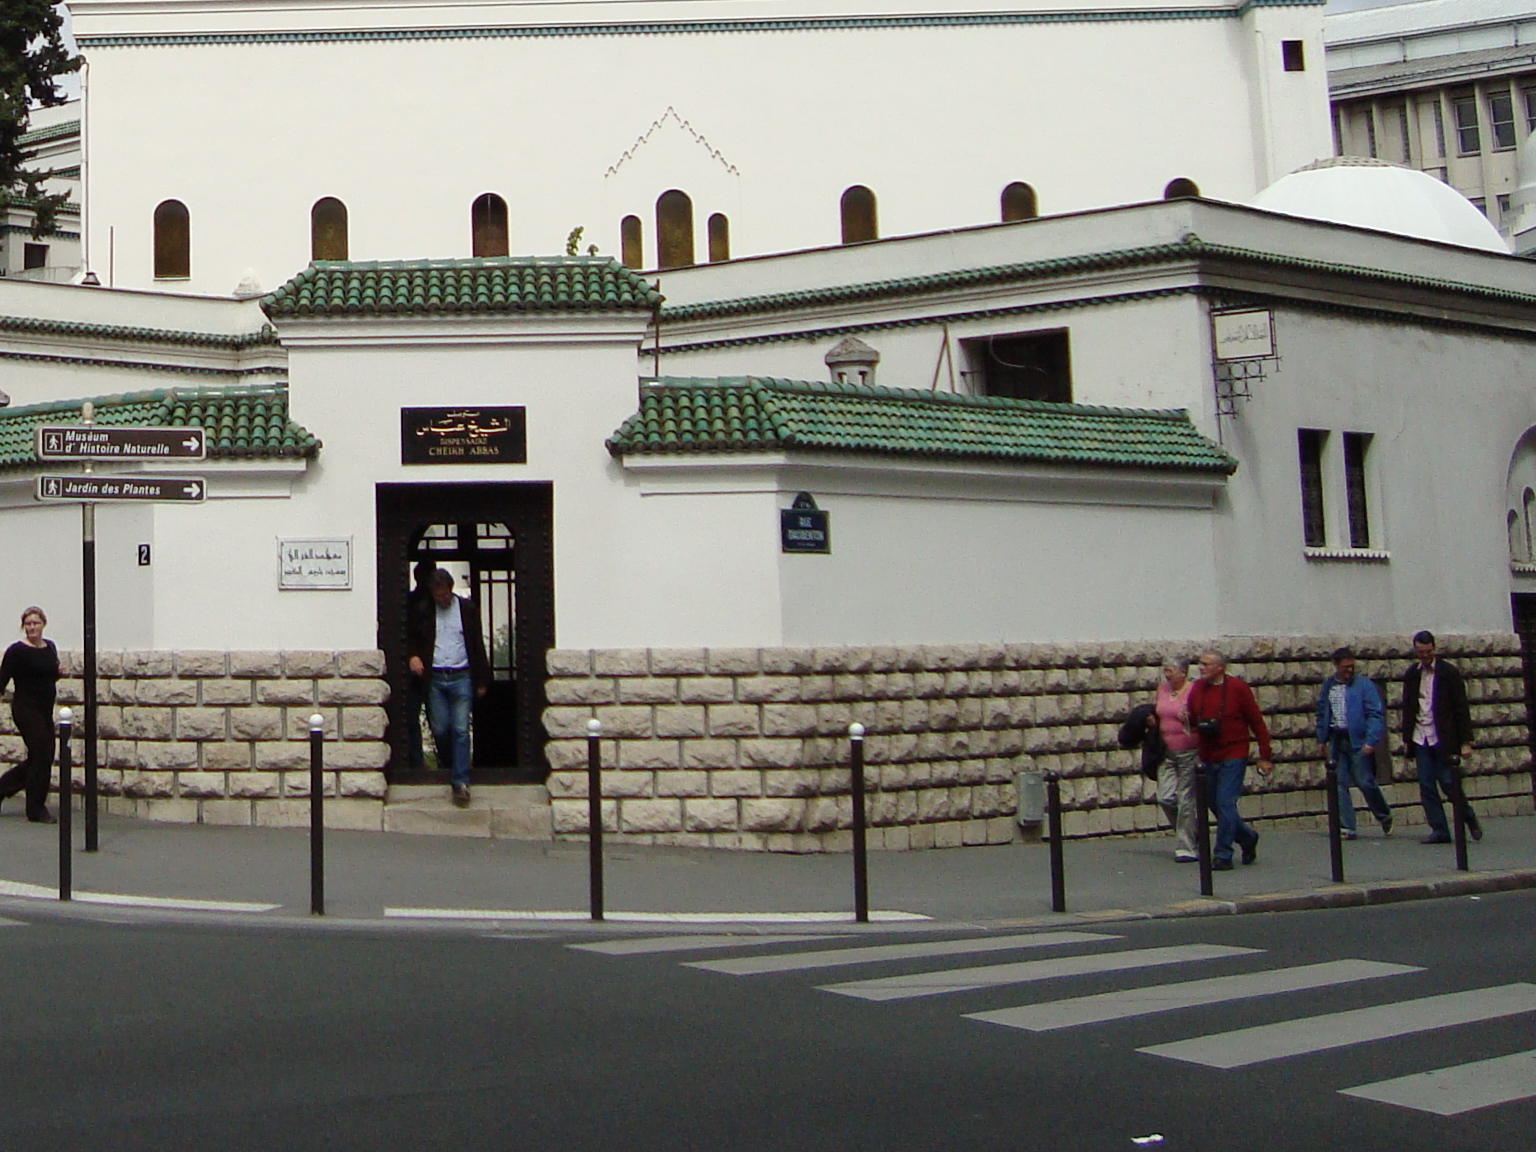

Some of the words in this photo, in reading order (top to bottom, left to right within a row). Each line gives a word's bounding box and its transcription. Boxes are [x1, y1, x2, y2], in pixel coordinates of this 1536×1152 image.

[79, 442, 120, 454] Histoire
[123, 443, 170, 455] Naturelle
[428, 446, 464, 456] CHEIKH
[469, 446, 500, 455] ABBAS
[65, 482, 98, 494] Jardin
[101, 483, 120, 494] des
[122, 483, 161, 495] Plantes
[140, 545, 148, 564] 2
